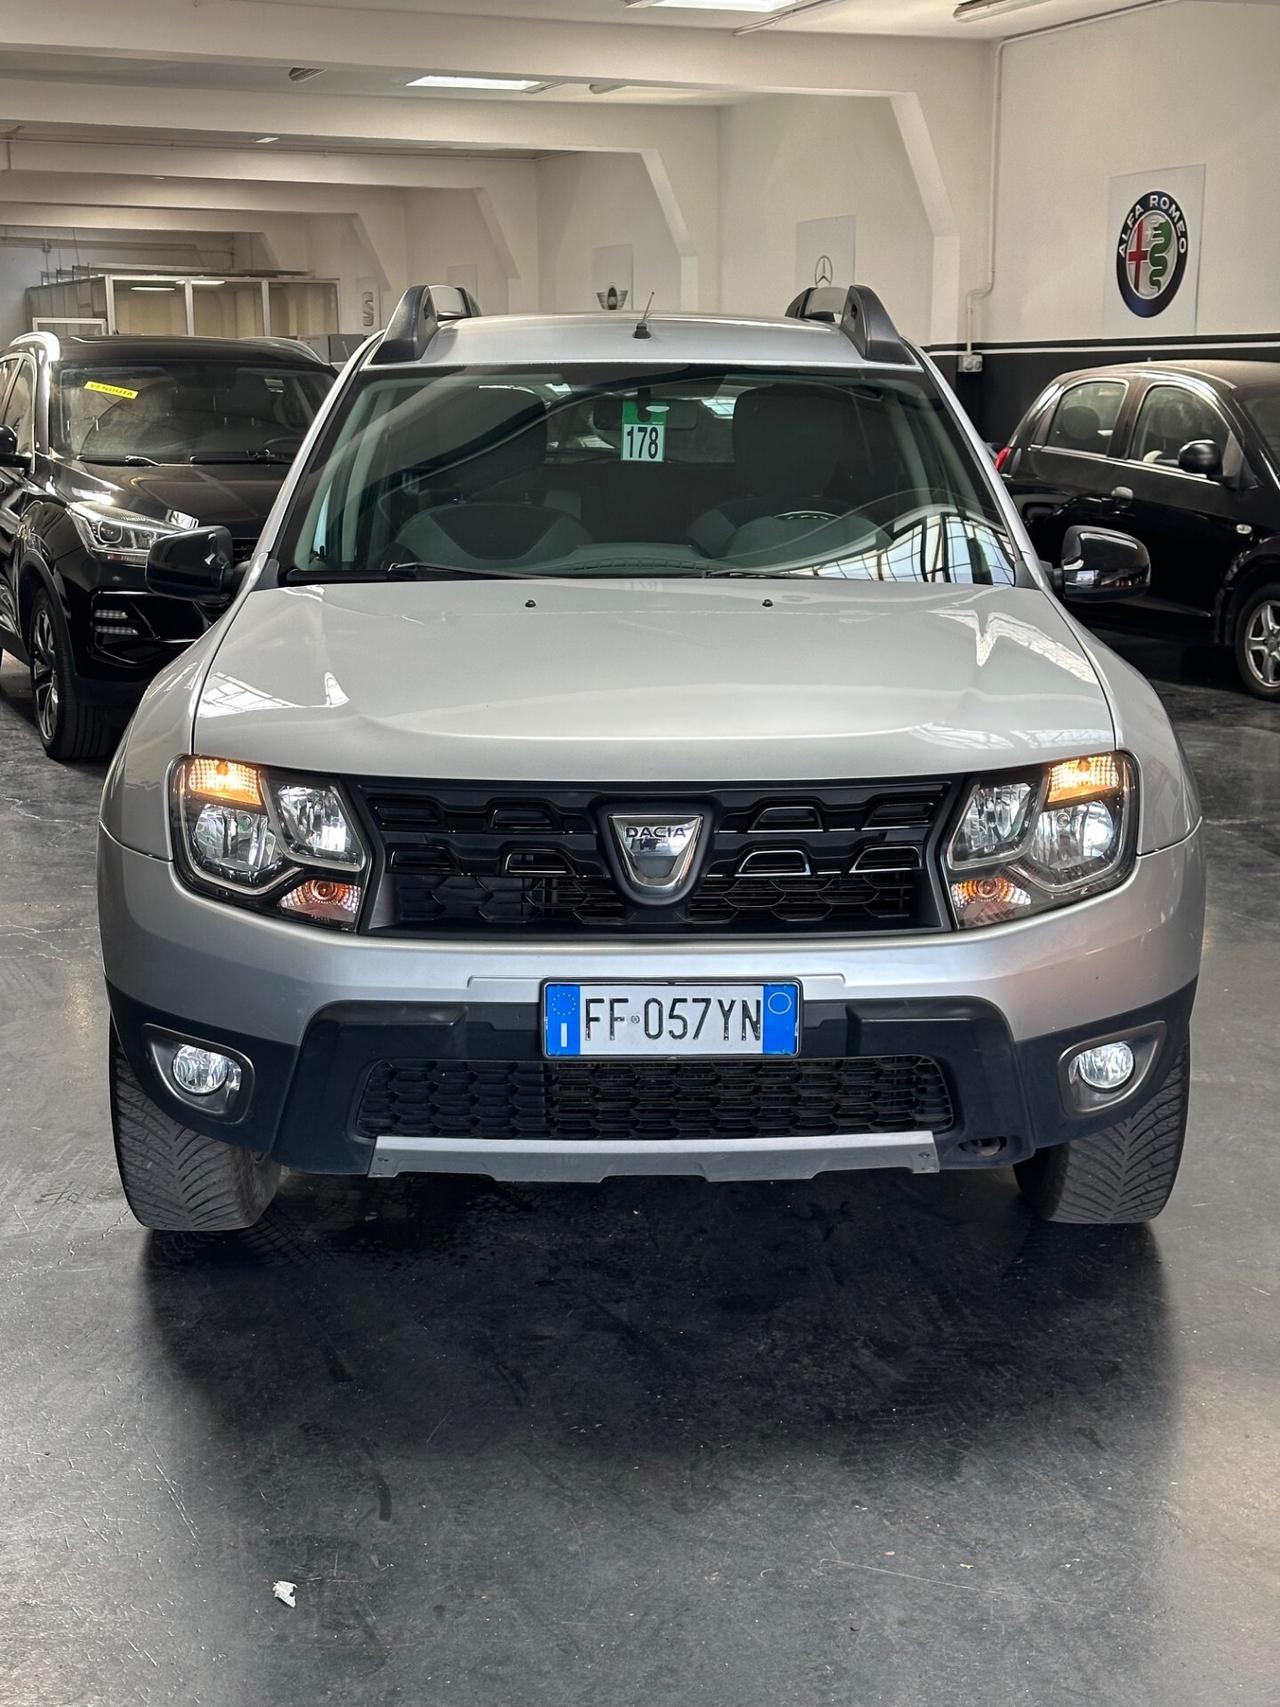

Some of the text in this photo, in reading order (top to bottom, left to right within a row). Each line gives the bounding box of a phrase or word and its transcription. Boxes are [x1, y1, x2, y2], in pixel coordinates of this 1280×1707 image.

[1118, 195, 1187, 258] ALFA ROMEO
[627, 426, 659, 459] 178
[626, 826, 687, 838] DACIA
